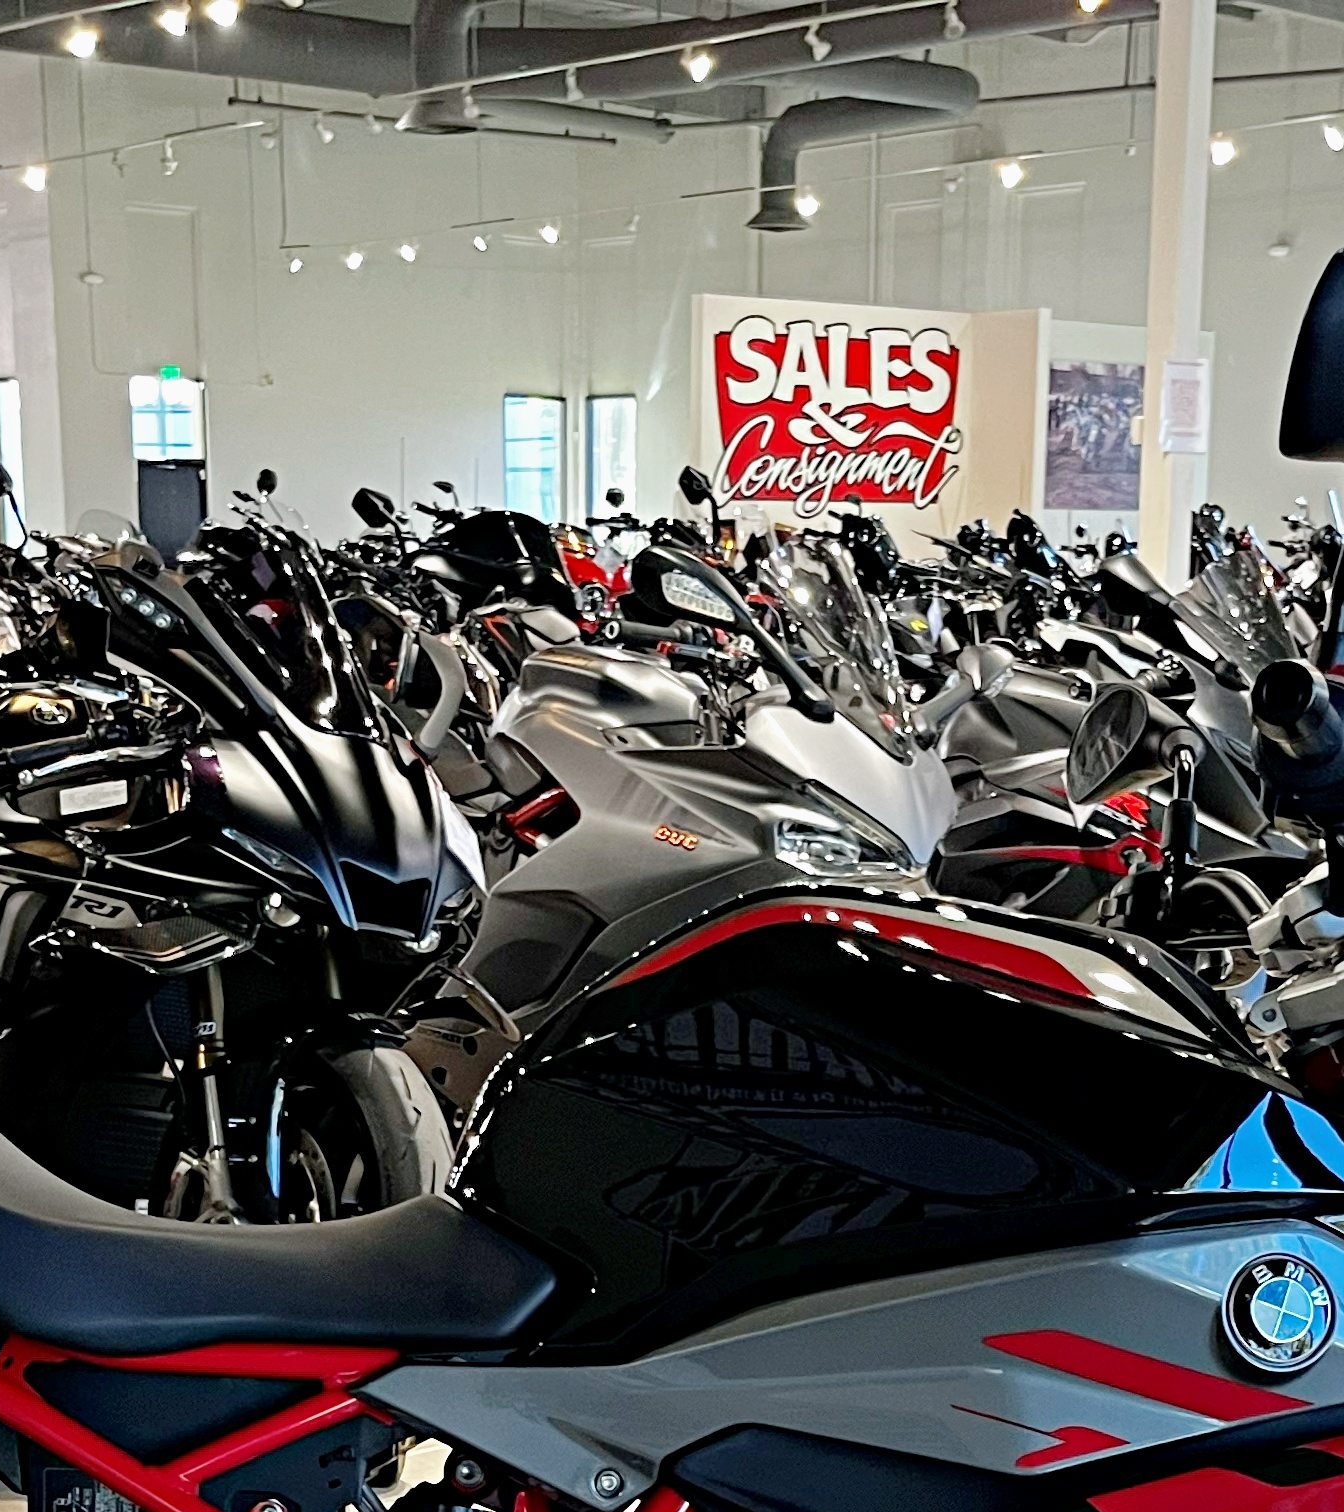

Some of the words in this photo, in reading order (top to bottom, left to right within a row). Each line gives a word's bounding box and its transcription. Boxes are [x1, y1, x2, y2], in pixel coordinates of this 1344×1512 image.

[726, 315, 953, 414] SALES
[788, 401, 875, 447] &
[713, 415, 963, 518] Consignment
[1252, 1261, 1329, 1306] BMW
